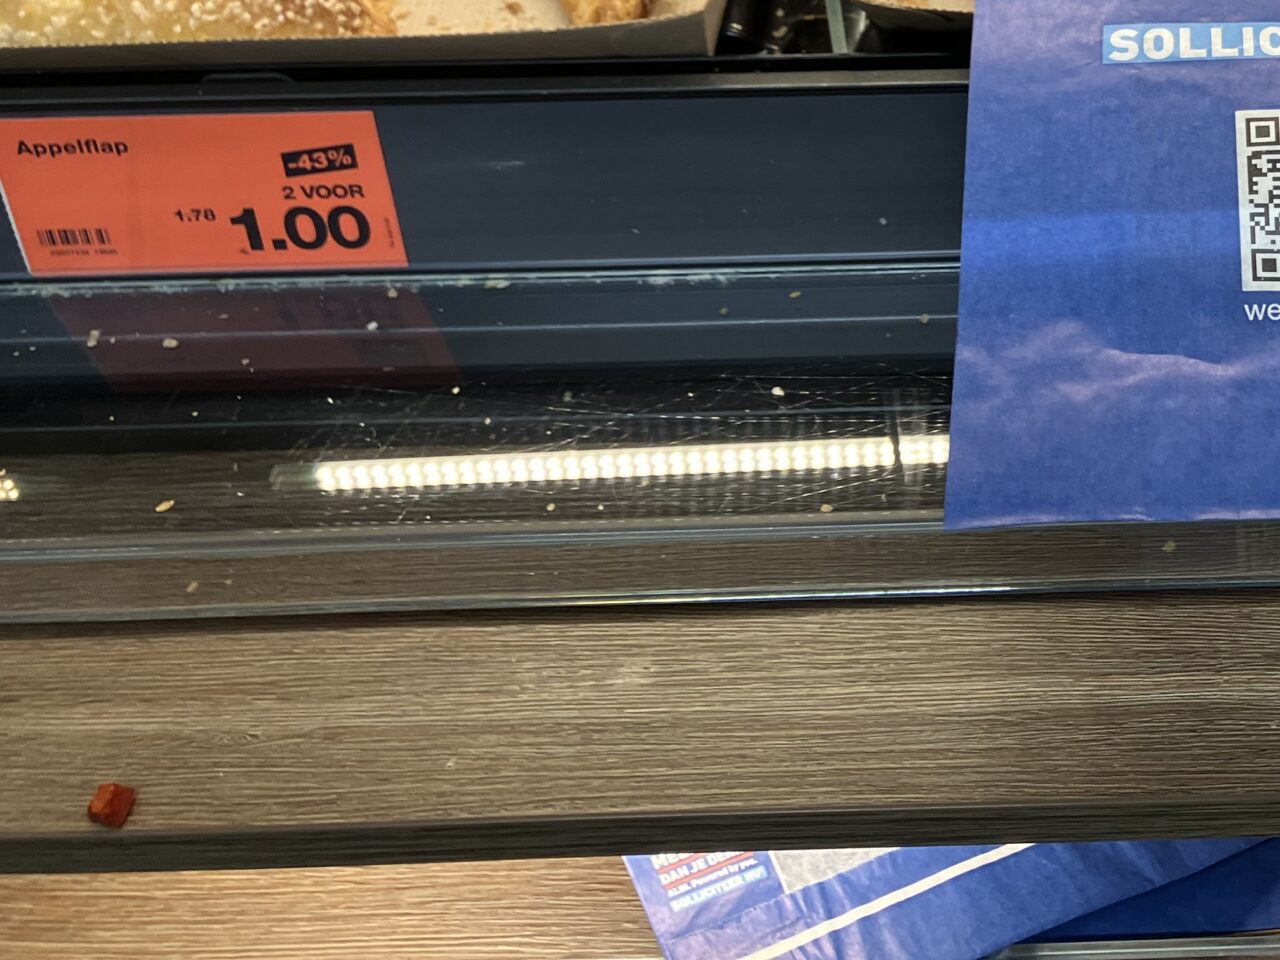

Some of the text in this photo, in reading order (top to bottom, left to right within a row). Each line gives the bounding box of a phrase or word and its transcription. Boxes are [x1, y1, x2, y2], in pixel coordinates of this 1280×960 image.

[17, 138, 129, 158] Appelflap
[287, 148, 352, 170] -43%
[282, 184, 365, 200] 2 VOOR
[229, 205, 372, 251] 1.00
[659, 865, 691, 885] DAN
[689, 858, 708, 874] JE
